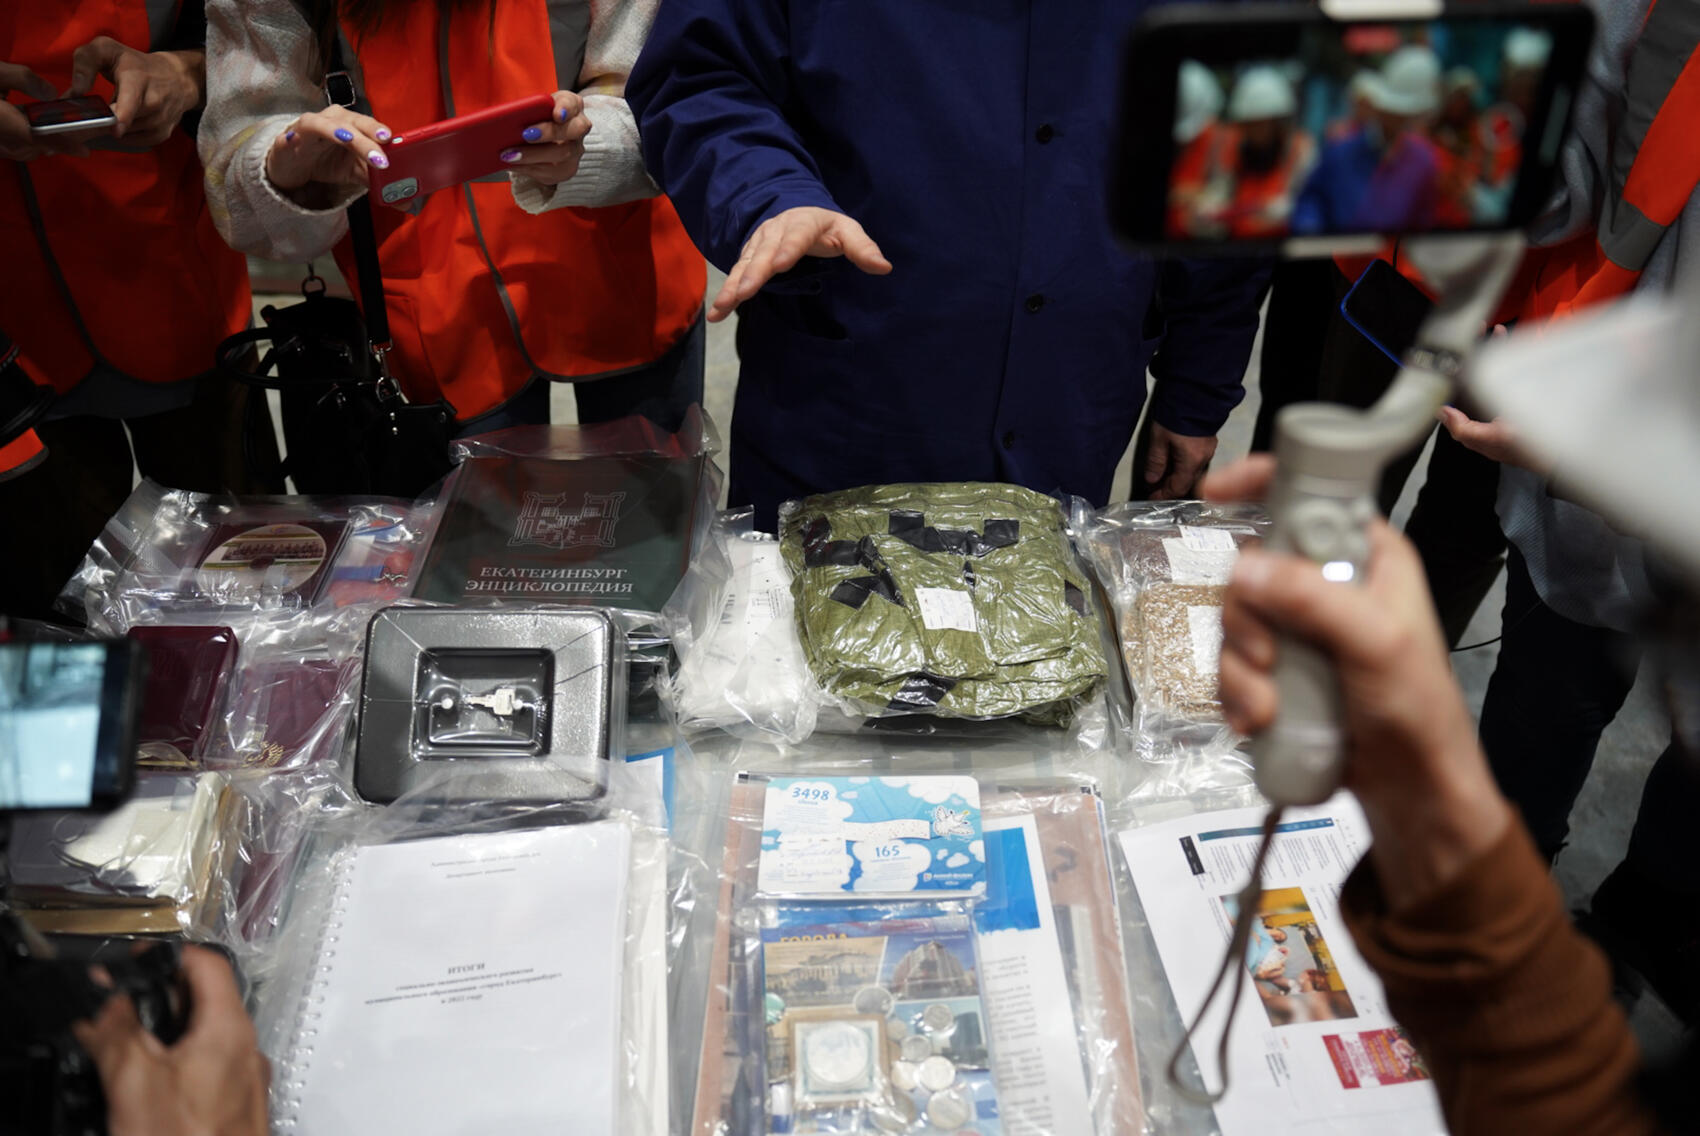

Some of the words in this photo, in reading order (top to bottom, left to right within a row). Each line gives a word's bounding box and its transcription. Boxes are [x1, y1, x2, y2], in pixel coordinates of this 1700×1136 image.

[480, 567, 628, 579] ЕКАТЕРИНБУРГ
[465, 580, 633, 593] ЭНЦИКЛОПЕДИЯ
[792, 787, 830, 800] 3498
[875, 845, 901, 857] 165
